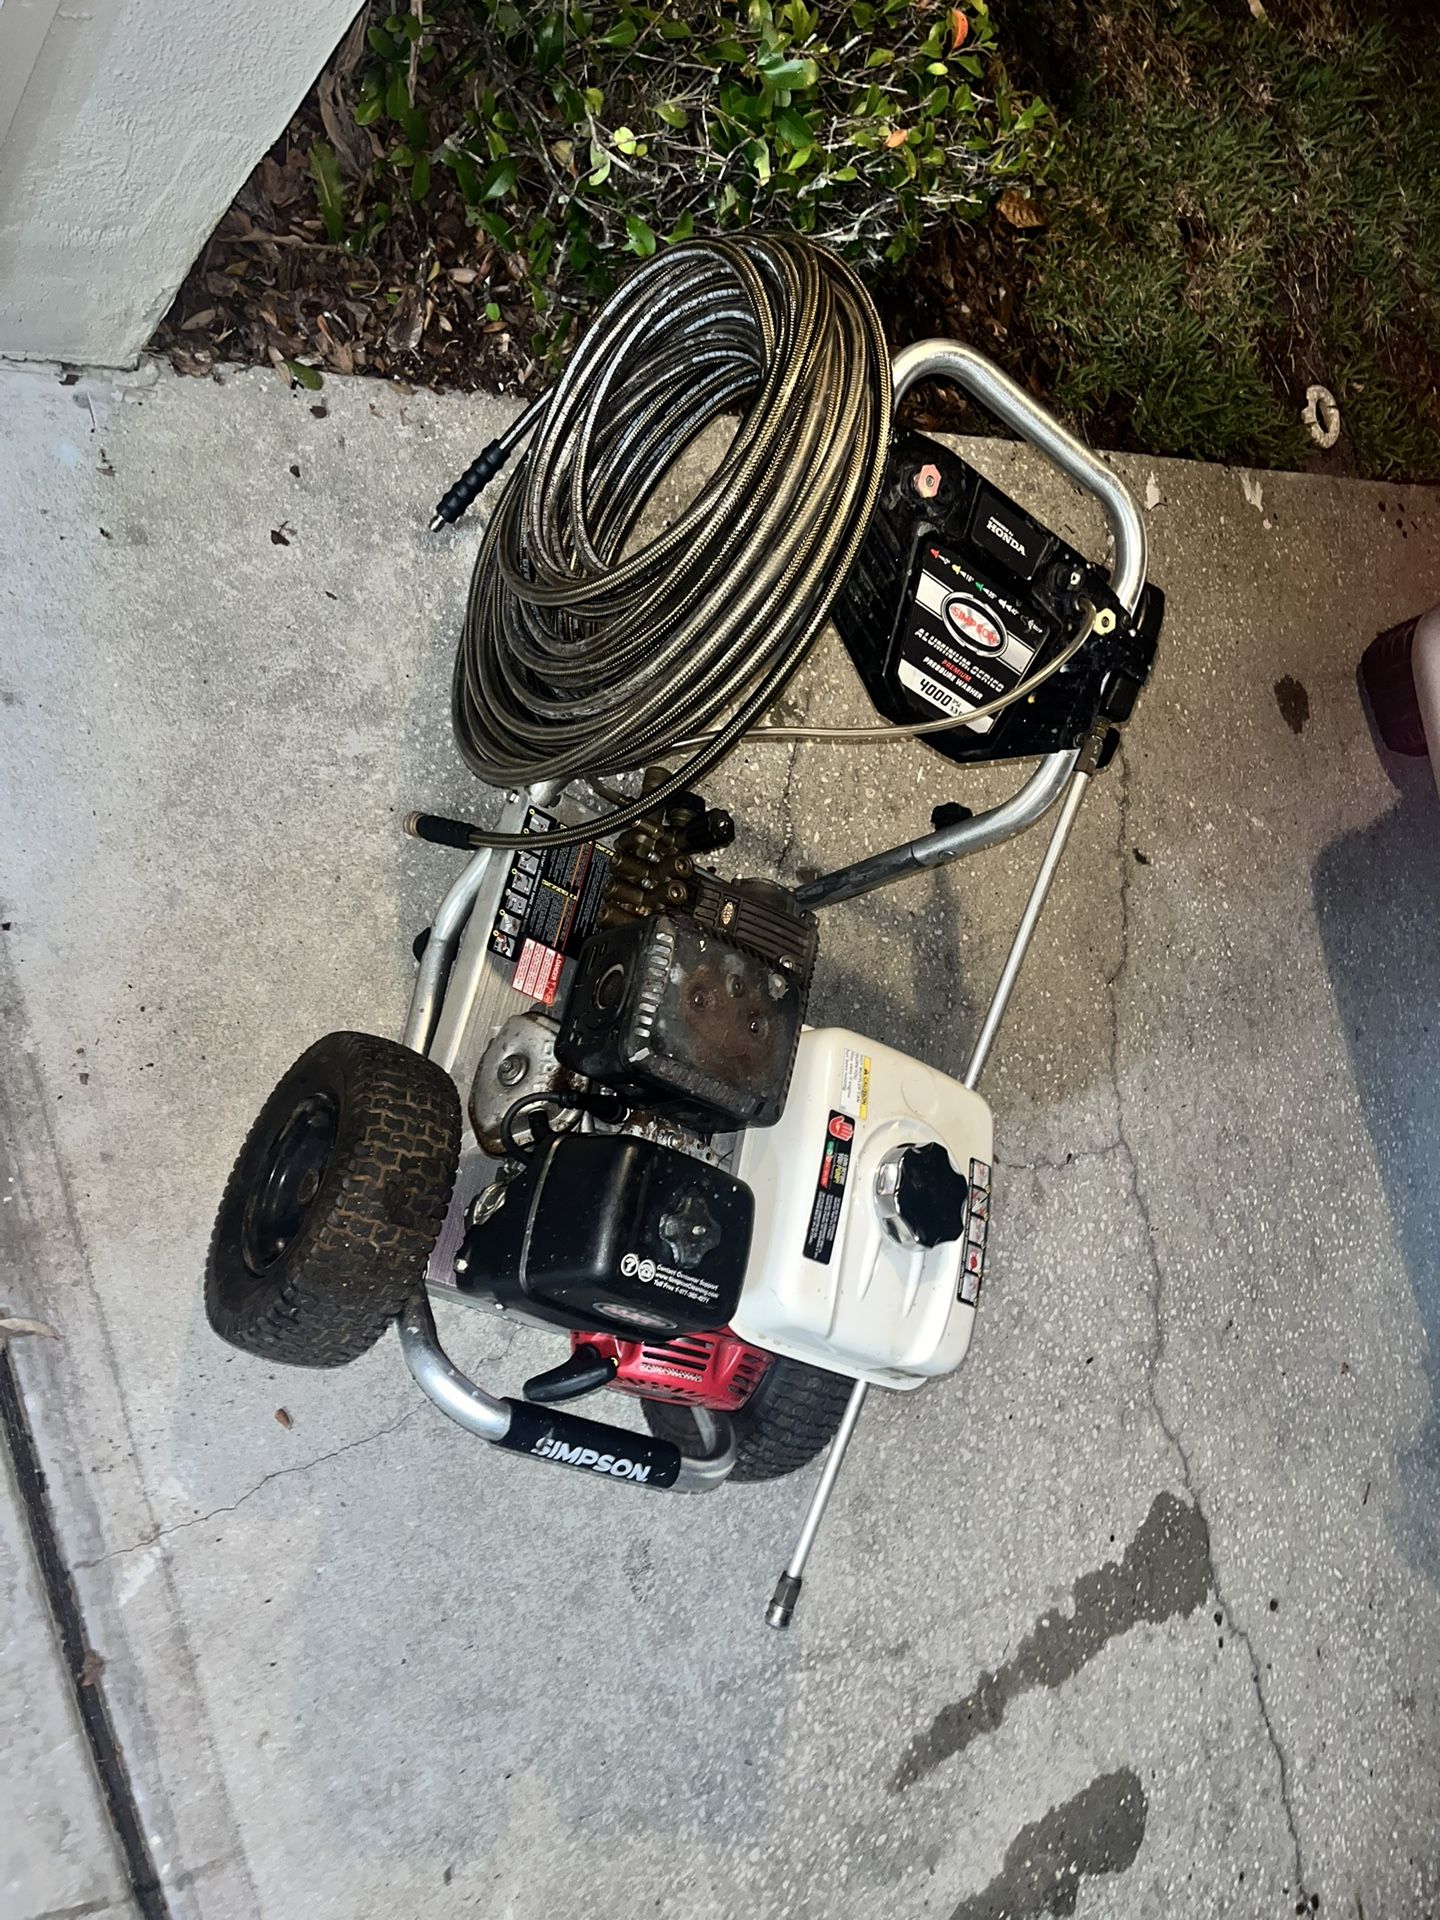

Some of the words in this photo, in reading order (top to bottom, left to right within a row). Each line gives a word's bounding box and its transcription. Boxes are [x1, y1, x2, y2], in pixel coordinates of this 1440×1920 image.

[985, 519, 1026, 556] HONDA
[949, 605, 1000, 645] SIMPSON
[914, 627, 973, 670] ALUMINUM
[921, 655, 957, 682] PRESSURE
[954, 677, 984, 700] WASHER
[940, 658, 972, 683] PREMIUM
[915, 677, 953, 708] 4000
[550, 958, 561, 981] DANGER
[860, 1076, 868, 1105] CAUTION
[656, 1262, 676, 1276] Contact
[675, 1269, 700, 1284] Customer
[698, 1278, 719, 1291] Support
[530, 1435, 652, 1482] SIMPSON
